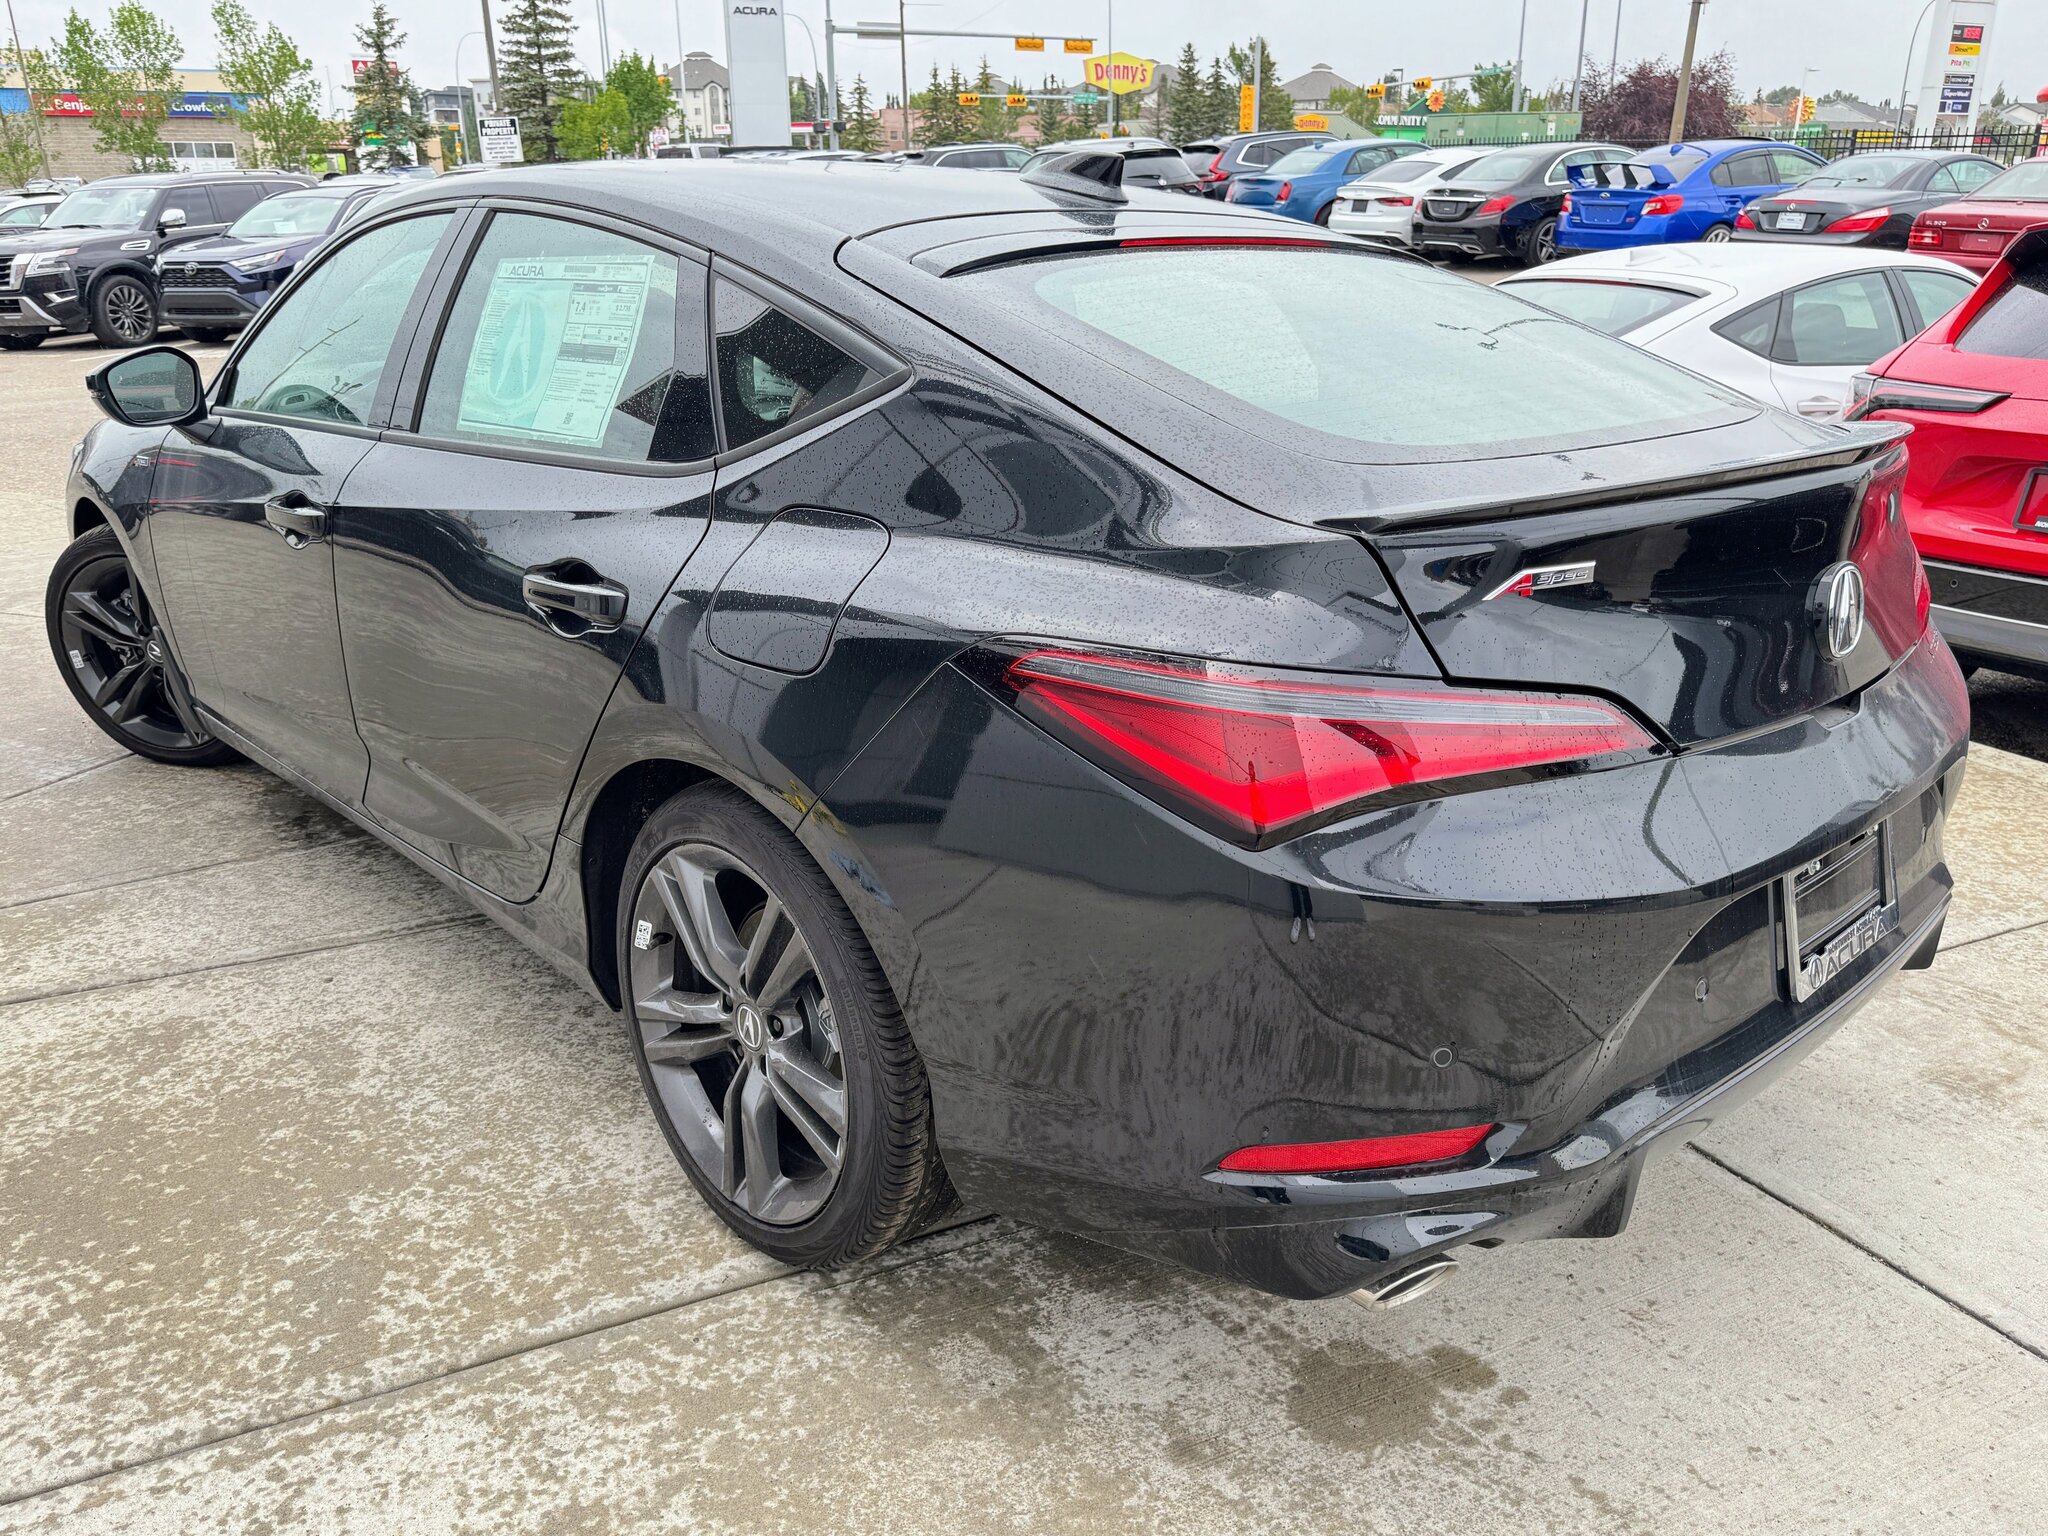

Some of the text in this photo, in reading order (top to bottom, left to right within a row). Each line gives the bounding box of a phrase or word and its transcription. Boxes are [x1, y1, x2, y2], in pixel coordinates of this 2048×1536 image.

[733, 6, 777, 16] ACURA
[1094, 63, 1147, 84] Denny's
[484, 119, 512, 128] PRIVATE
[481, 127, 515, 136] PROPERTY
[509, 265, 545, 277] ACURA
[1825, 916, 1887, 981] ACURA
